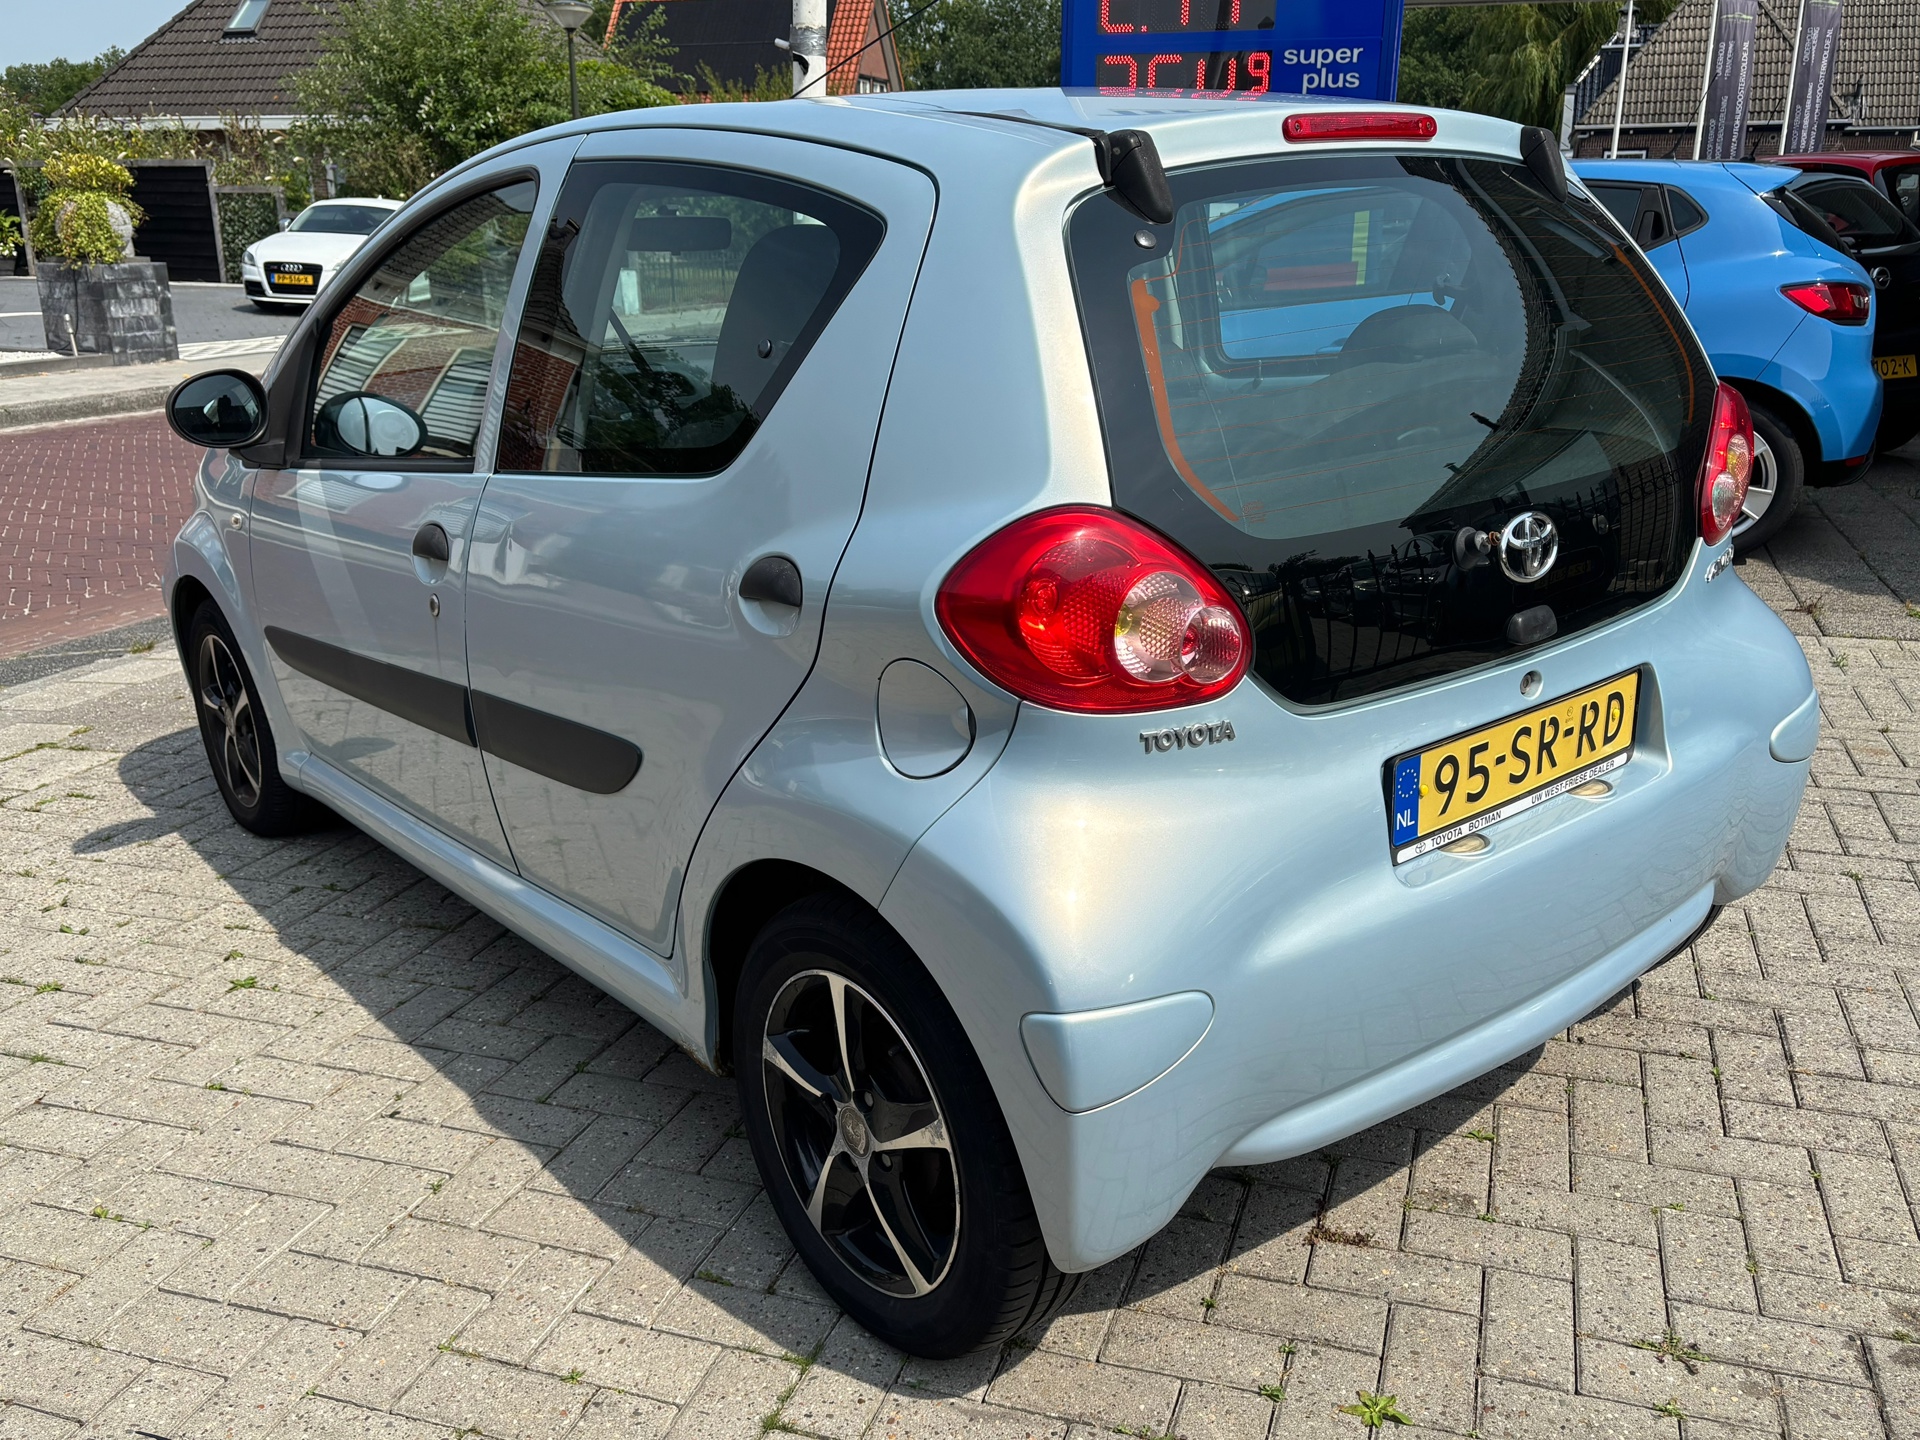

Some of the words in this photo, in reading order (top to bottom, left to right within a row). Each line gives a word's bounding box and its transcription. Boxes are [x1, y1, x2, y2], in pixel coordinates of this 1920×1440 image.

[1283, 47, 1364, 69] super
[1302, 67, 1360, 95] plus
[1139, 719, 1236, 754] TOYOTA
[1434, 691, 1625, 817] 95-SR-RD
[1396, 808, 1415, 831] NL
[1431, 828, 1463, 848] TOYOTA
[1468, 809, 1502, 833] BOTMAN
[1531, 793, 1543, 805] UW
[1544, 772, 1588, 798] WEST-FRIESE
[1588, 760, 1615, 779] DEALER
